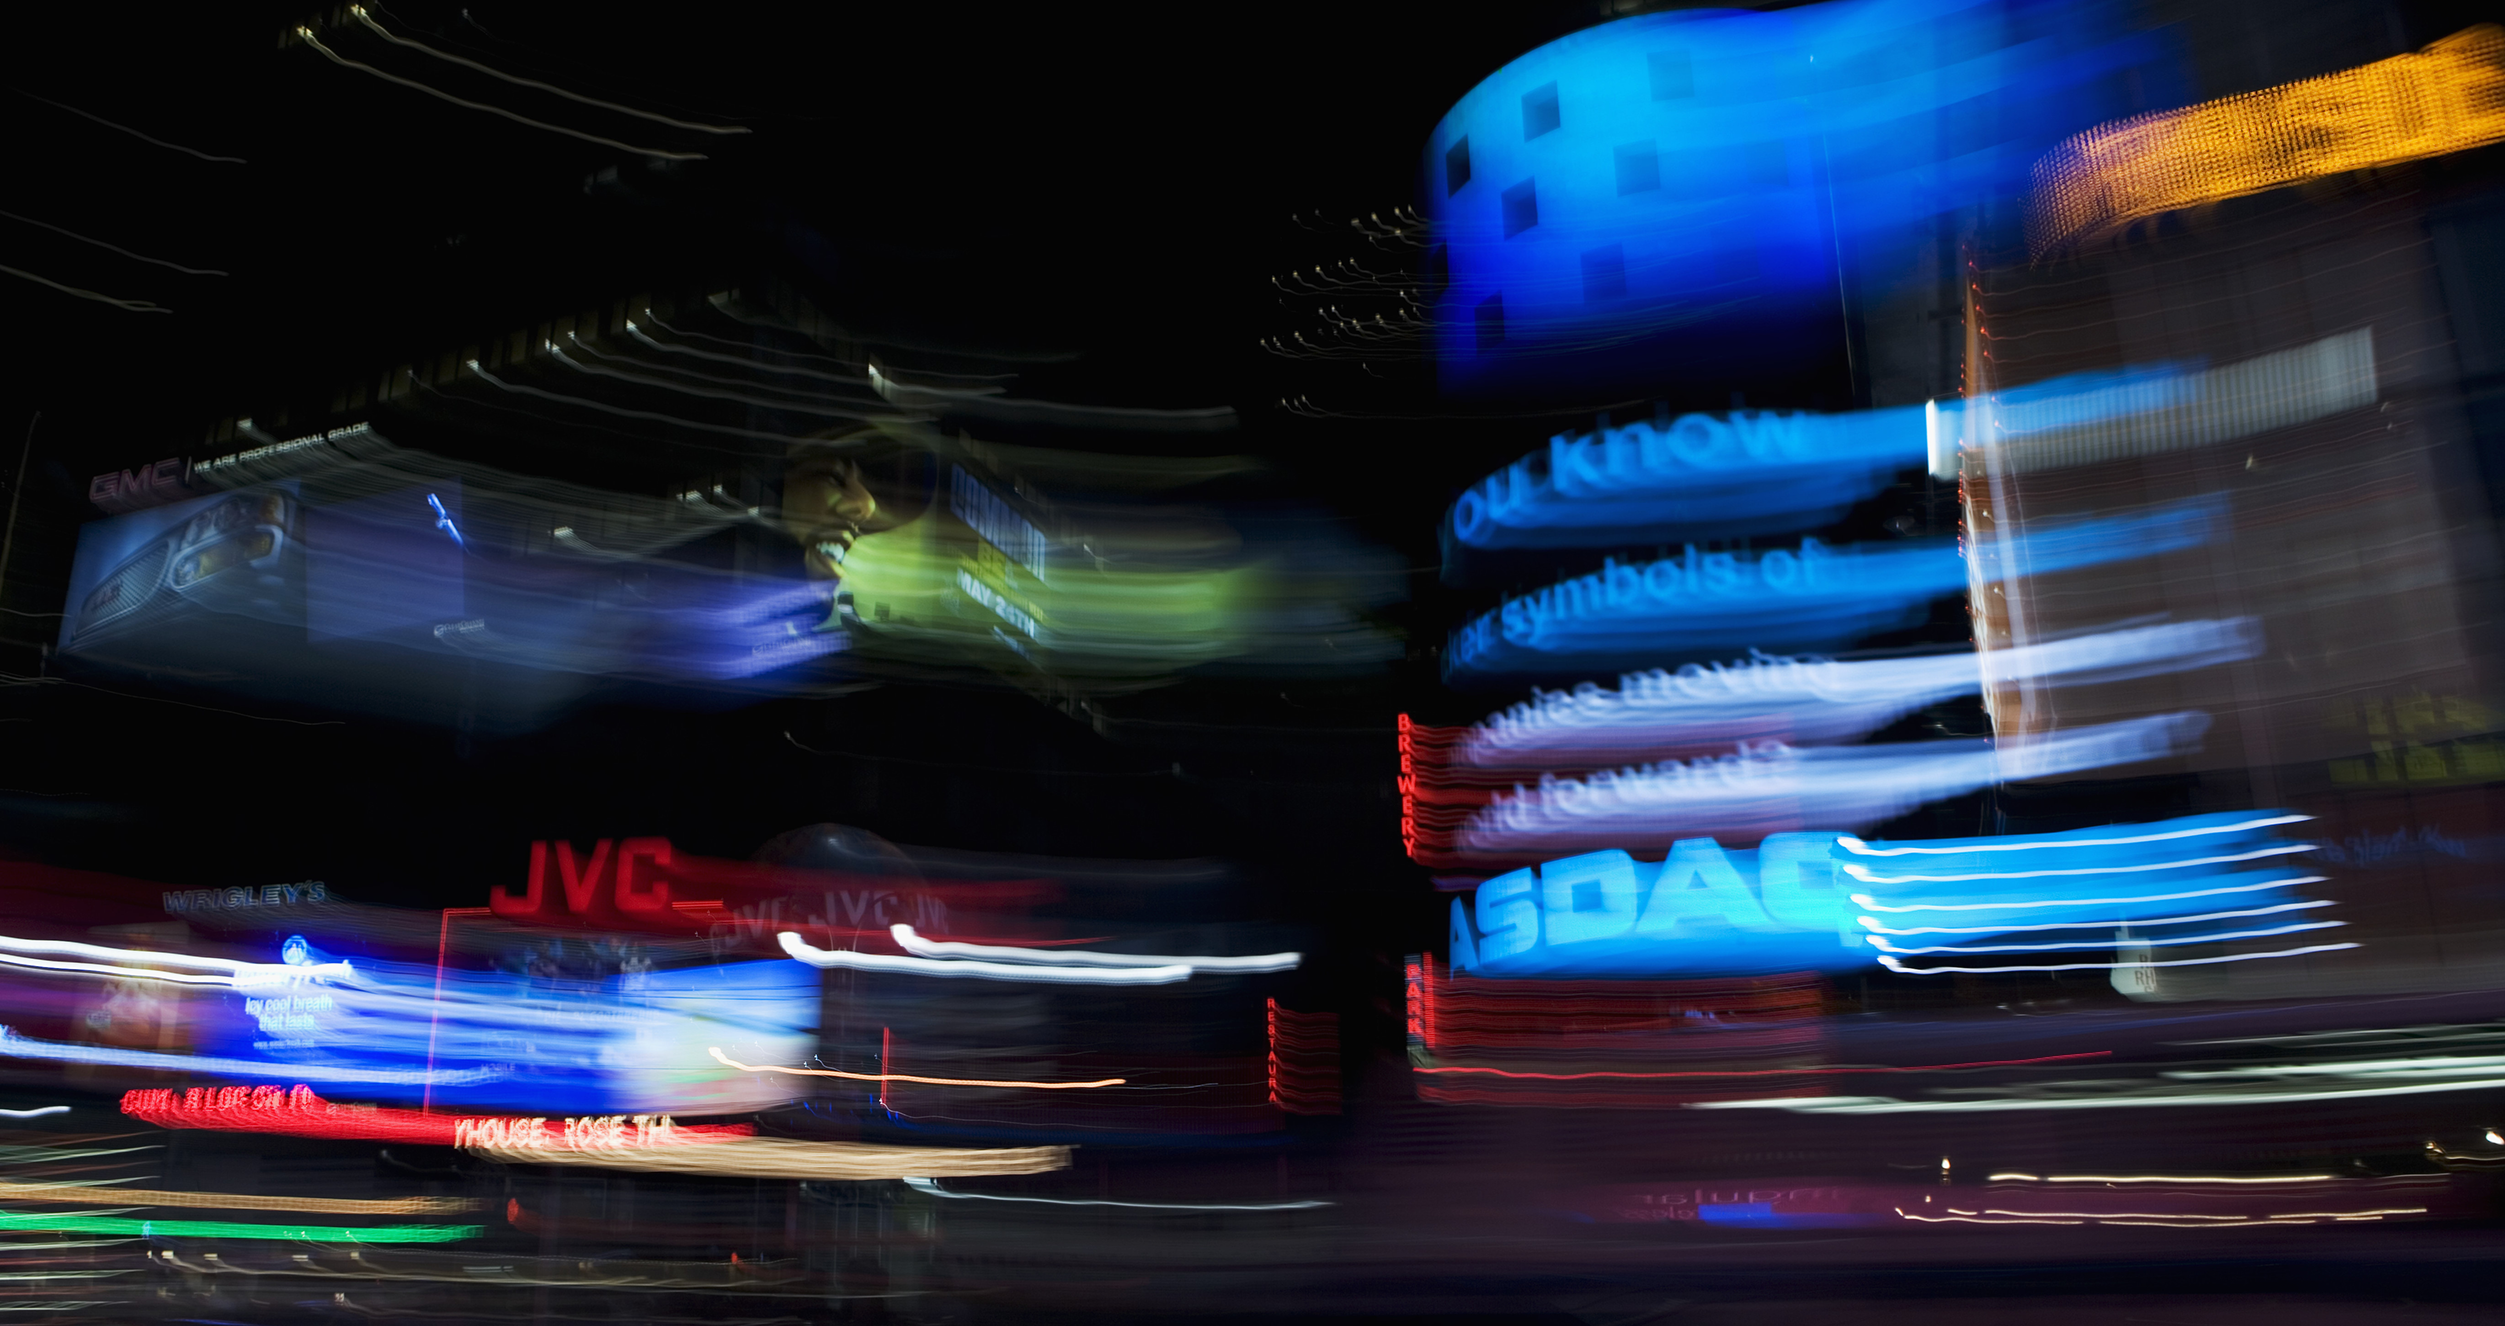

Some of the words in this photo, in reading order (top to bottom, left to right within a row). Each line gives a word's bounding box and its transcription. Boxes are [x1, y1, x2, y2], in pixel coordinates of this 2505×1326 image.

[194, 460, 211, 473] WE
[213, 453, 237, 468] ARE
[239, 433, 324, 462] PROFESSIONAL
[328, 421, 369, 442] GRADE
[1549, 408, 1812, 500] know
[90, 457, 180, 500] GMC
[957, 568, 992, 608] MAY
[1501, 543, 1738, 645] symbols
[1759, 537, 1826, 590] of
[1397, 713, 1417, 858] BREWERY
[161, 879, 326, 915] WRIGLEY'S
[489, 836, 672, 915] JVC
[808, 890, 898, 927] JVC
[265, 995, 291, 1014] cool
[294, 993, 333, 1013] breath
[1266, 998, 1277, 1102] RESTAURA
